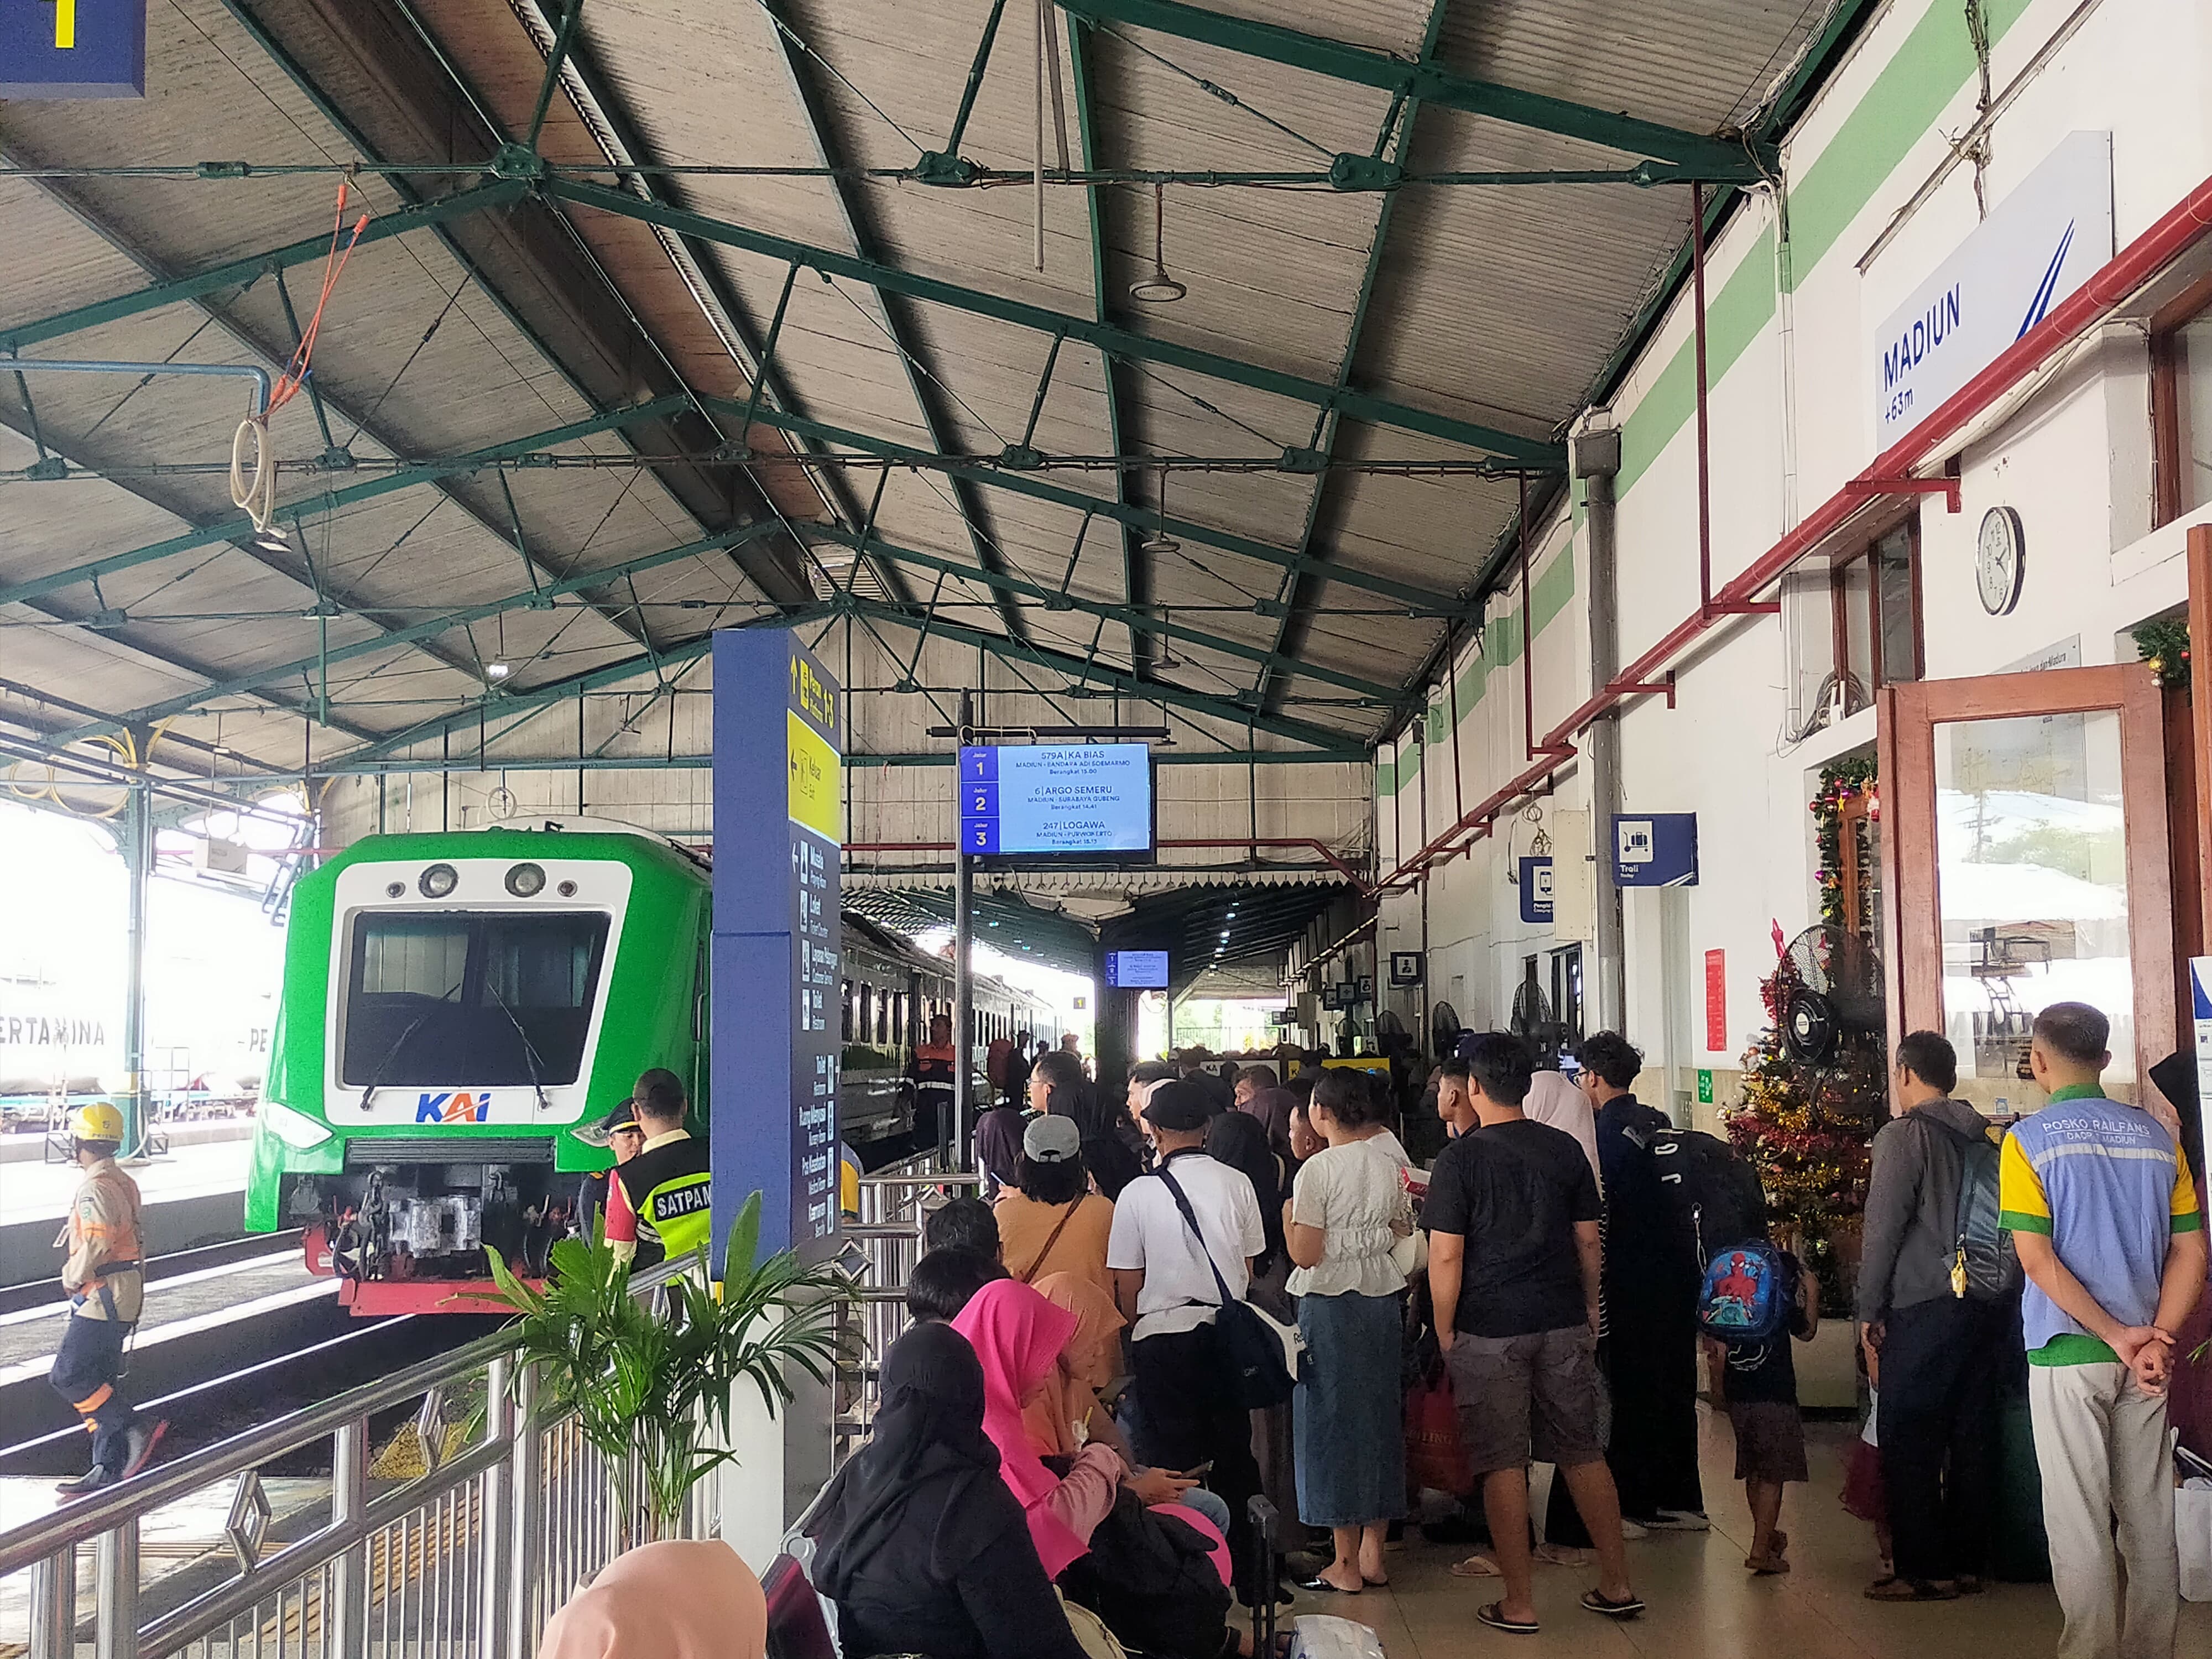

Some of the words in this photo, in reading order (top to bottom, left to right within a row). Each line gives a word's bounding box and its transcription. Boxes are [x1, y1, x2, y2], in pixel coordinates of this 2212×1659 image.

[1884, 282, 1960, 392] MADIUN
[1885, 388, 1913, 424] +63m
[976, 762, 983, 775] 1
[1074, 786, 1112, 794] SEMERU
[975, 797, 986, 811] 2
[976, 832, 987, 846] 3
[1619, 864, 1639, 873] Troli
[415, 1093, 491, 1123] KAI
[2042, 1119, 2088, 1133] POSKO
[2093, 1120, 2150, 1135] RAILFANS
[2103, 1135, 2136, 1144] MADIUN
